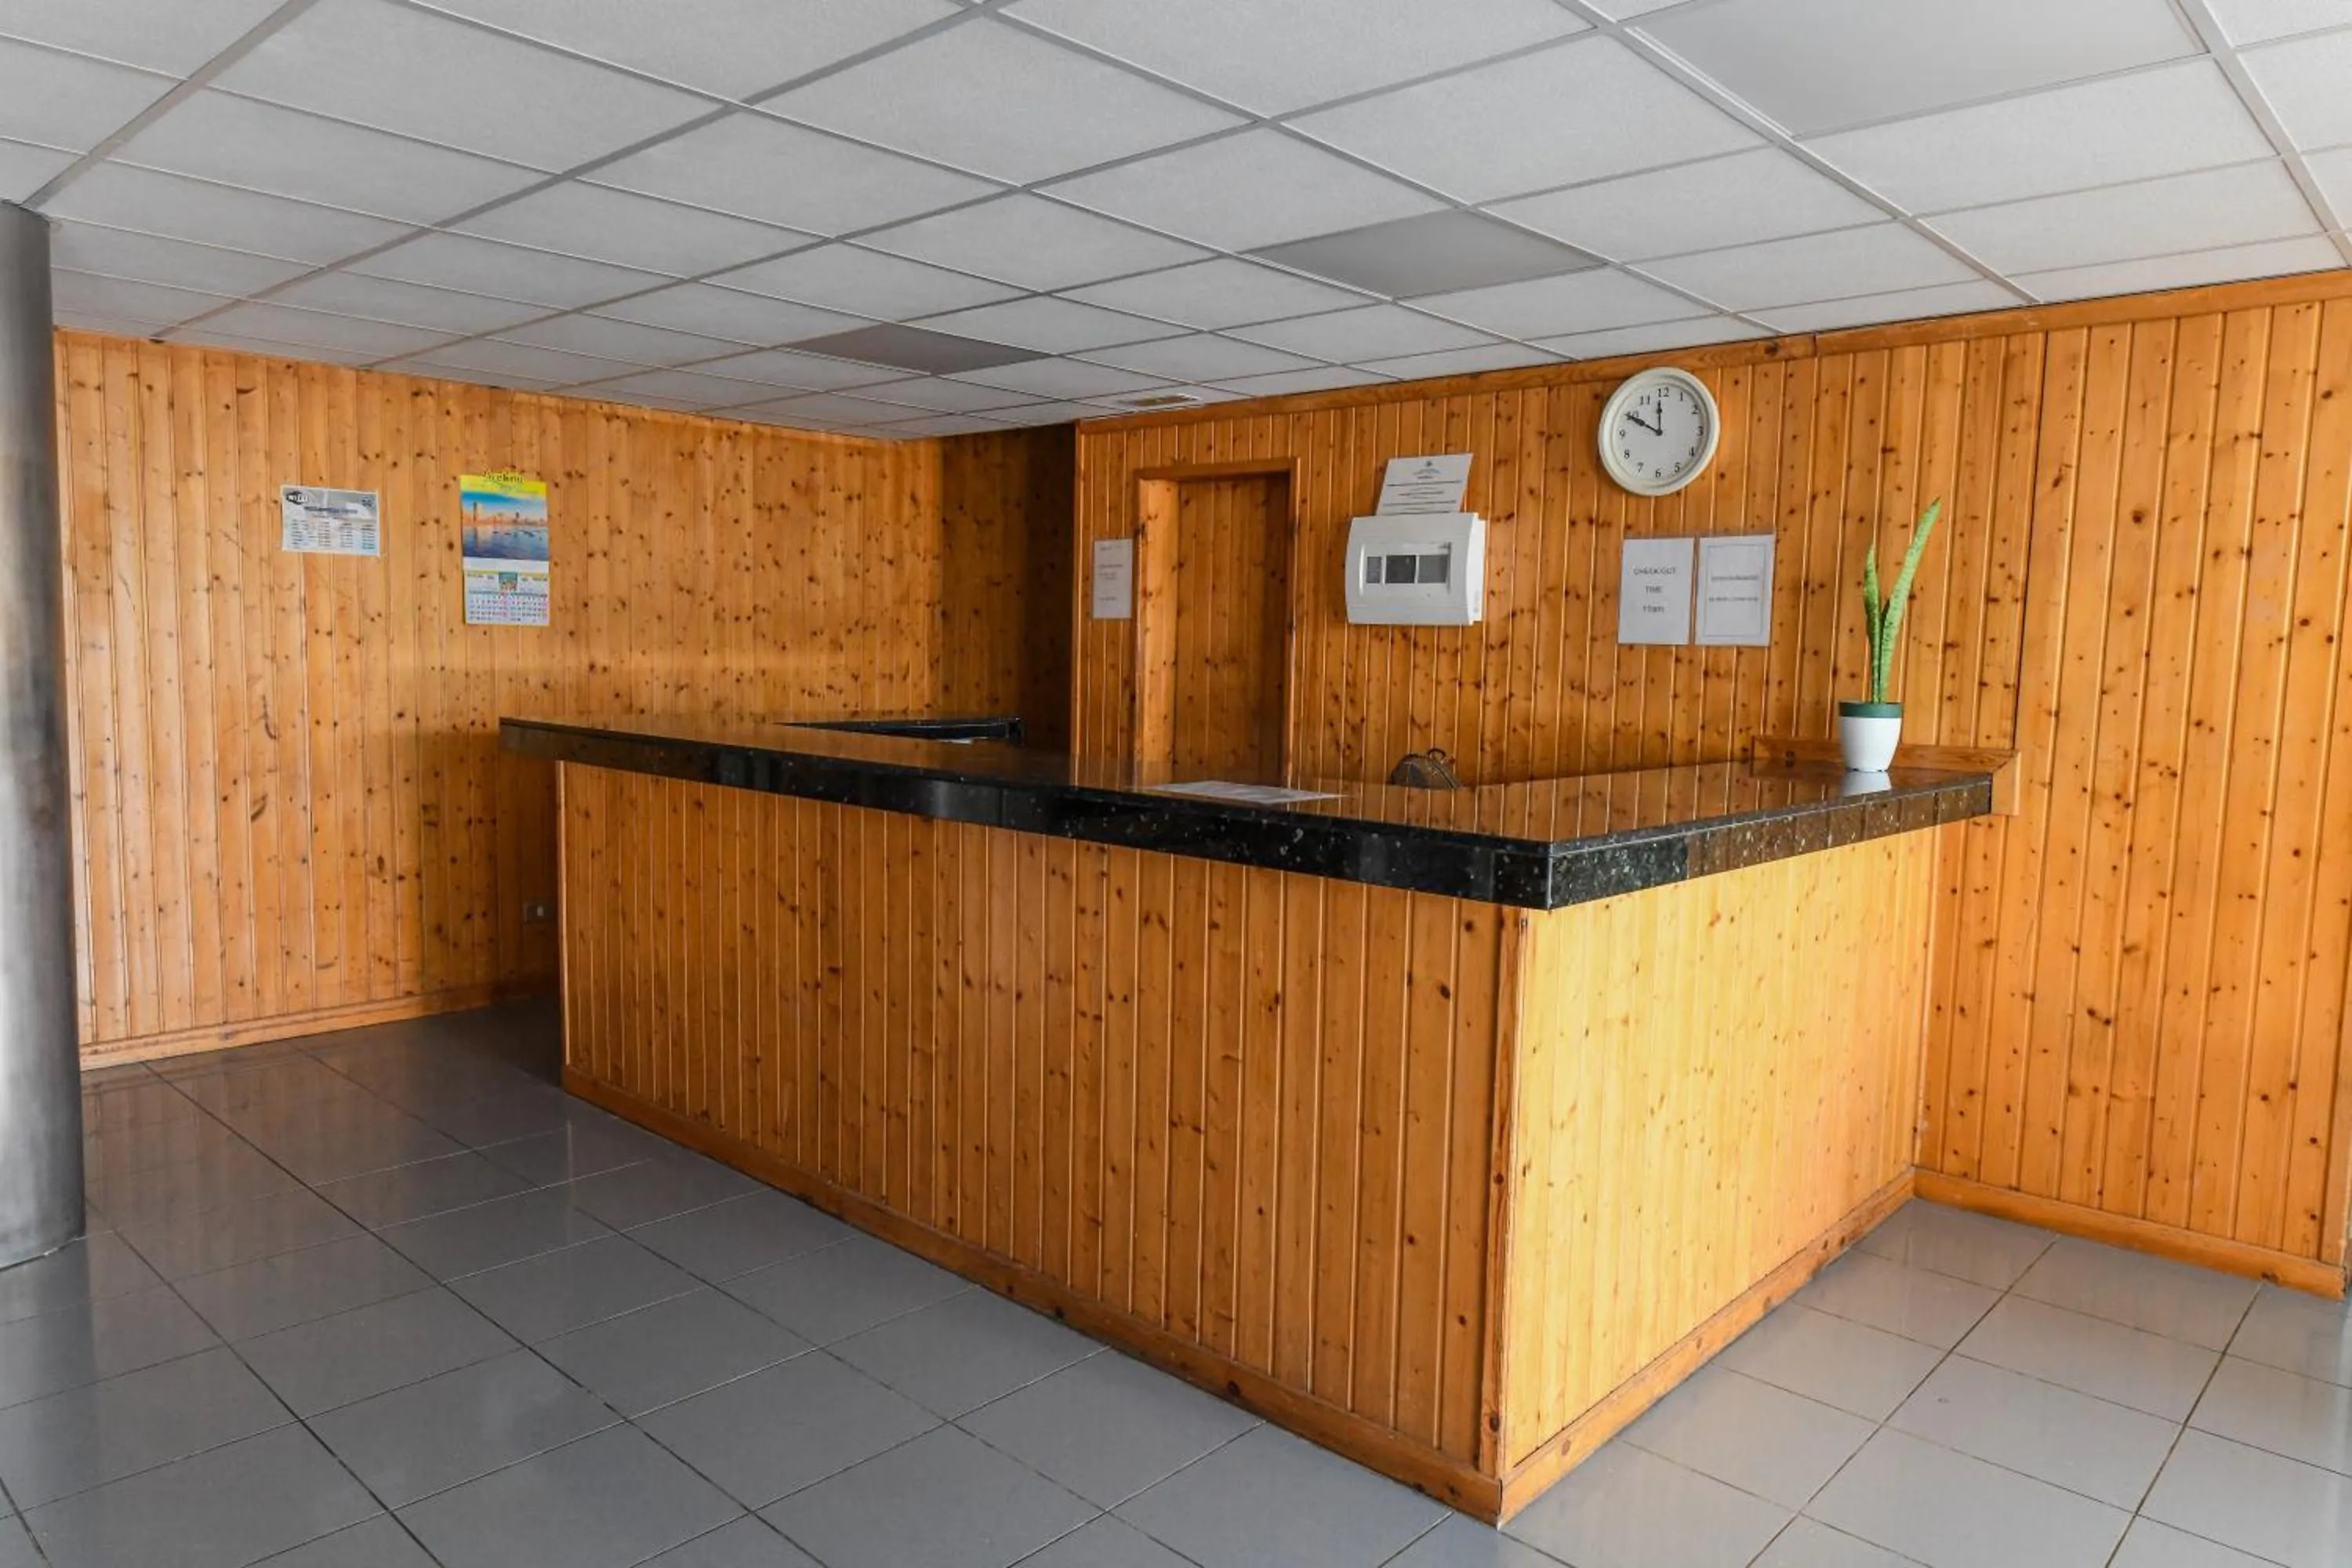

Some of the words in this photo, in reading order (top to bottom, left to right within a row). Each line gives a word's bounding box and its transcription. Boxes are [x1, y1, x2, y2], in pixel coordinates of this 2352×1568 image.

[1657, 387, 1669, 397] 12
[1639, 394, 1650, 405] 11
[1692, 404, 1700, 415] 2
[1619, 430, 1625, 439] 9
[1697, 426, 1704, 436] 3
[1624, 449, 1630, 459] 8
[1689, 446, 1695, 456] 4
[1637, 462, 1644, 473] 7
[1655, 468, 1661, 477] 6
[1675, 462, 1681, 473] 5
